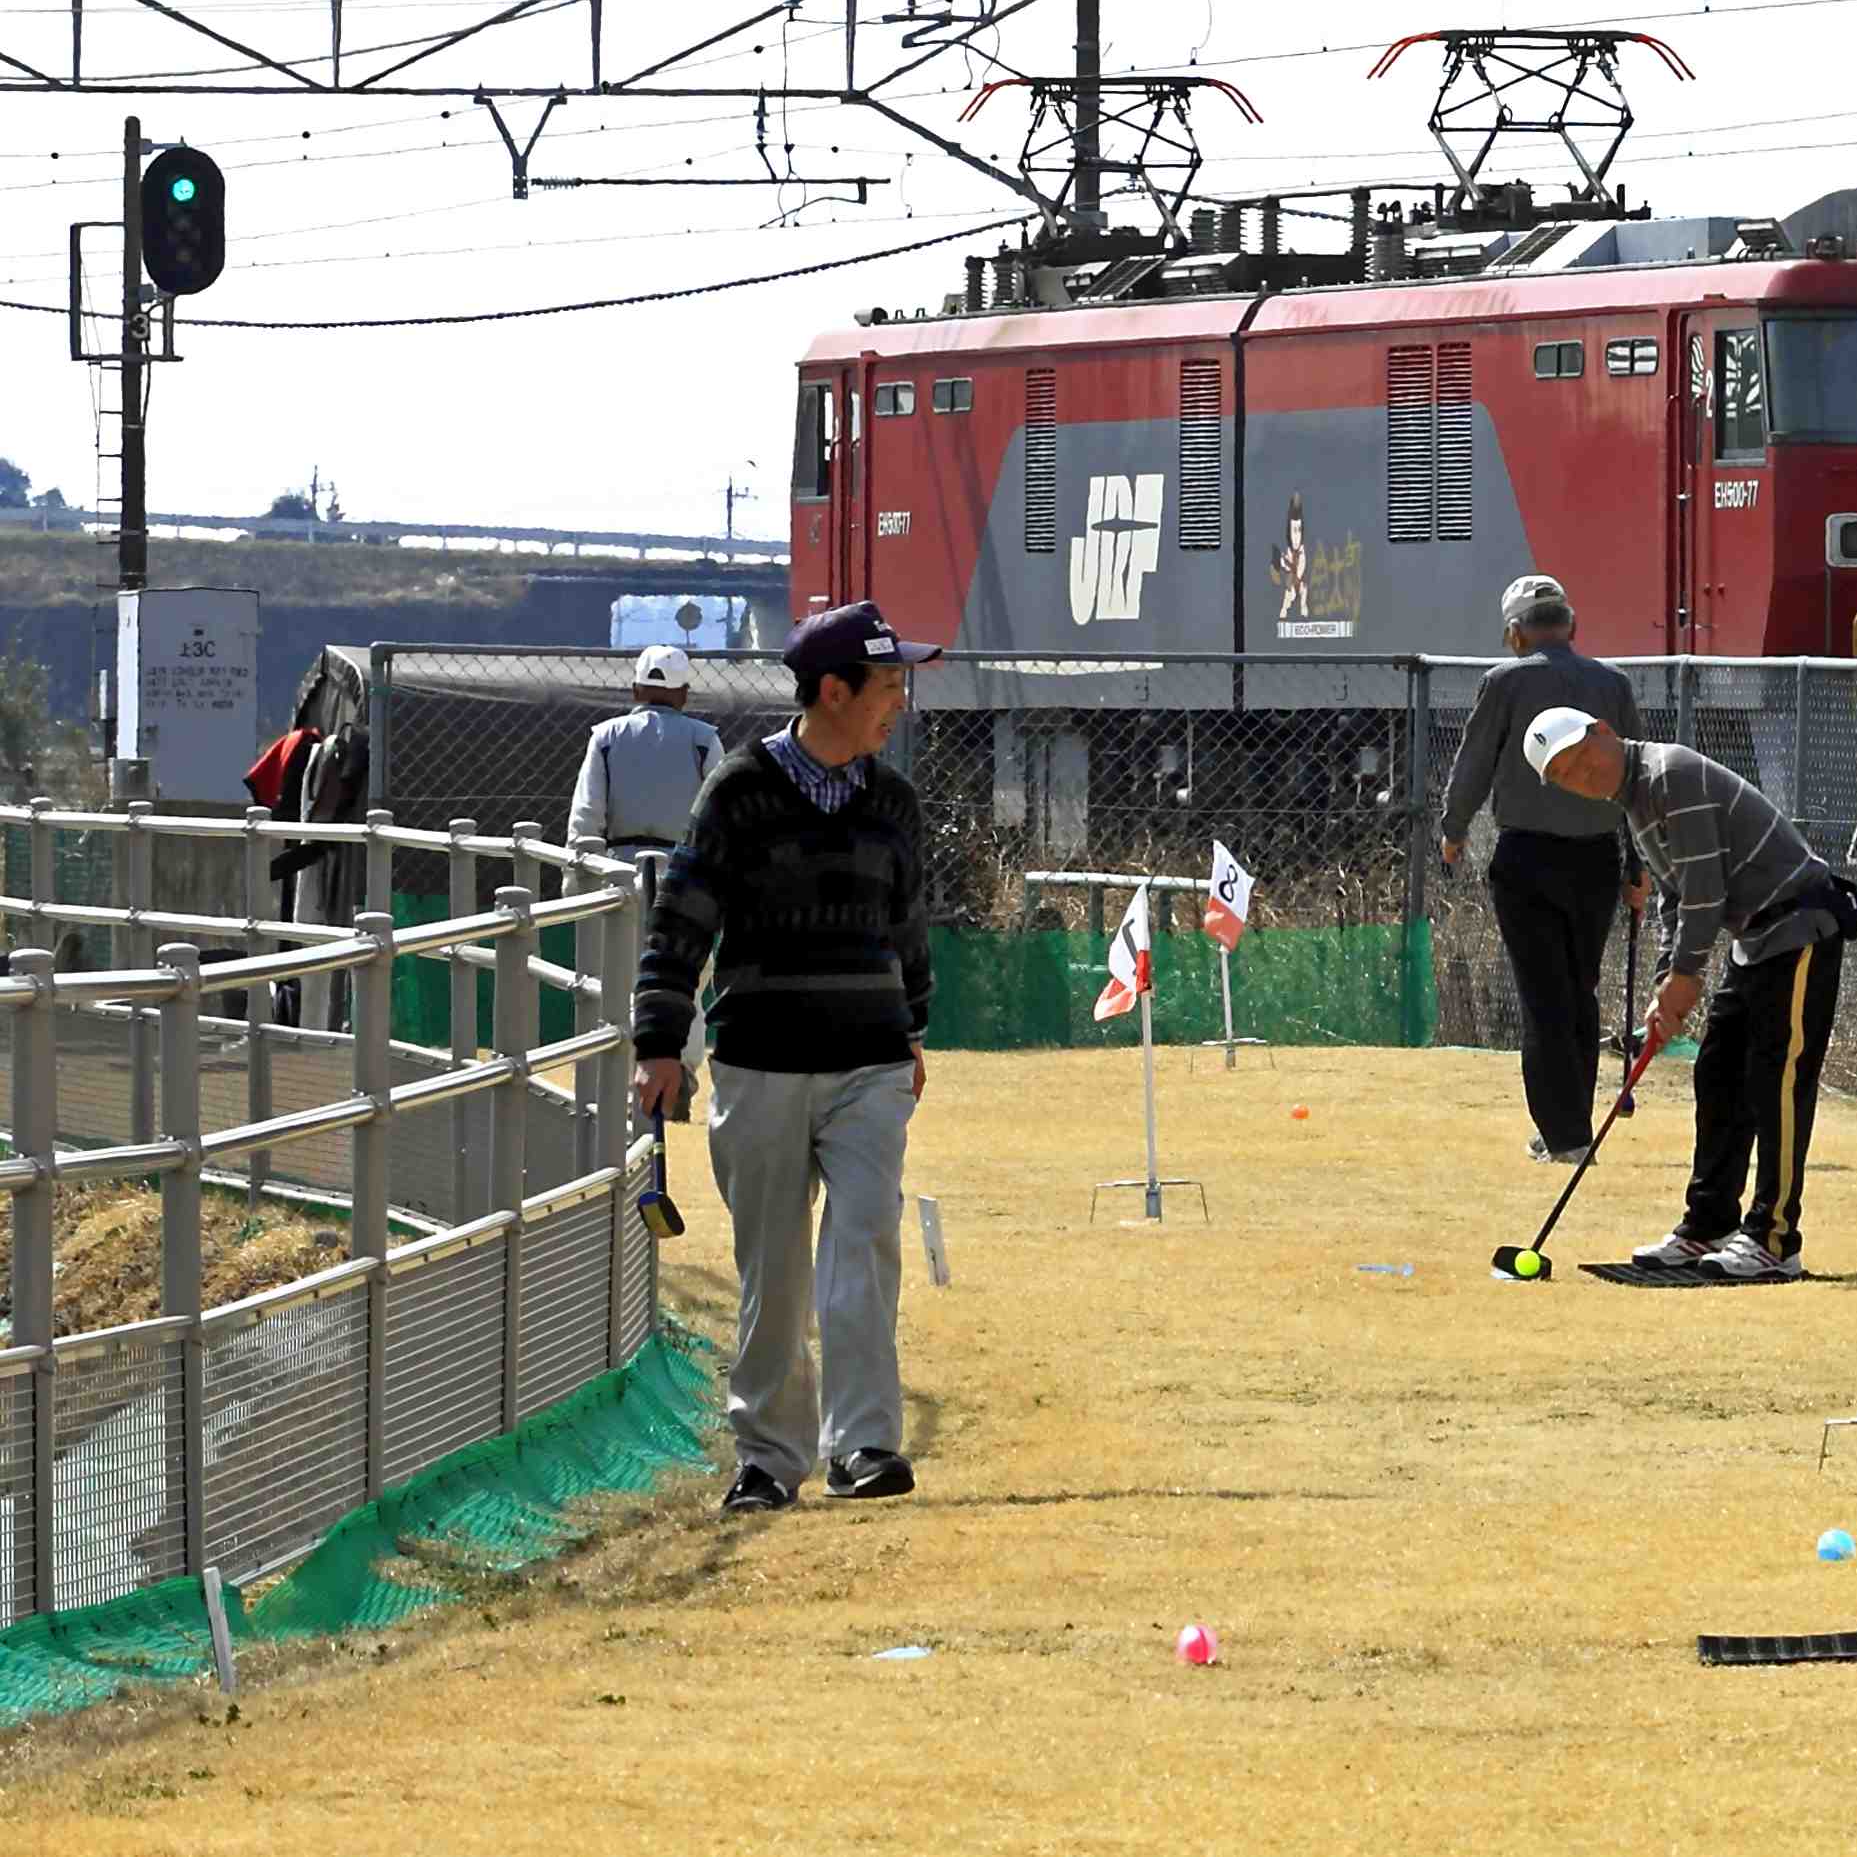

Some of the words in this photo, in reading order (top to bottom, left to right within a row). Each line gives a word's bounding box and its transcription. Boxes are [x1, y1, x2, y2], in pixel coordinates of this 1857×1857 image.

[133, 313, 149, 339] 3
[1714, 480, 1759, 509] EH500-77
[1070, 474, 1164, 626] JRF
[1218, 863, 1238, 904] 8
